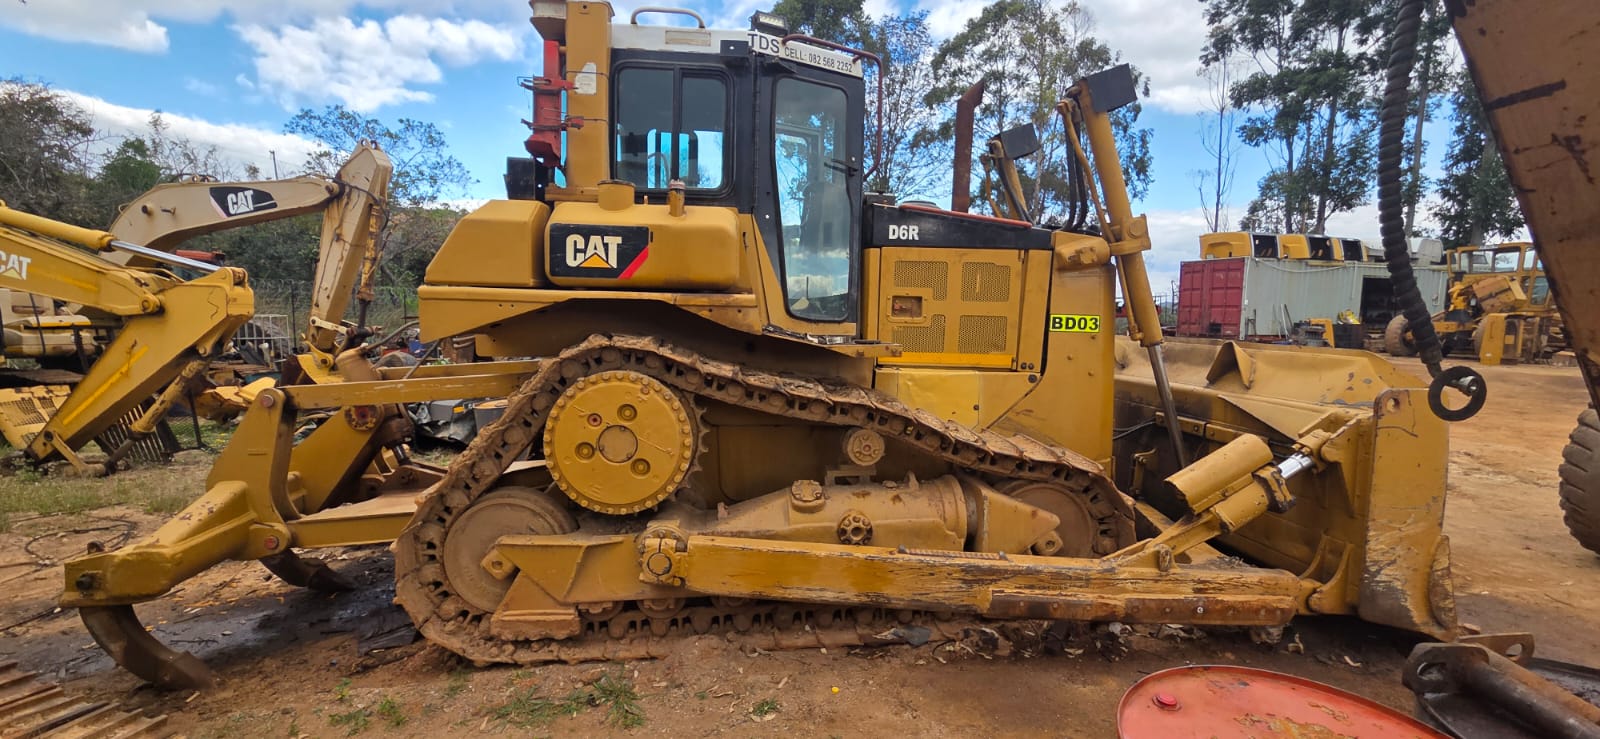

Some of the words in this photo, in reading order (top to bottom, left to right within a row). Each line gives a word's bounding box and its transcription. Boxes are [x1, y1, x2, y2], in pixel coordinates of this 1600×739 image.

[747, 33, 780, 54] TDS
[808, 52, 821, 64] 082
[822, 56, 835, 68] 568
[836, 60, 853, 72] 2252
[227, 189, 254, 215] CAT
[888, 224, 919, 241] D6R
[565, 233, 622, 269] CAT
[1051, 316, 1099, 331] BD03
